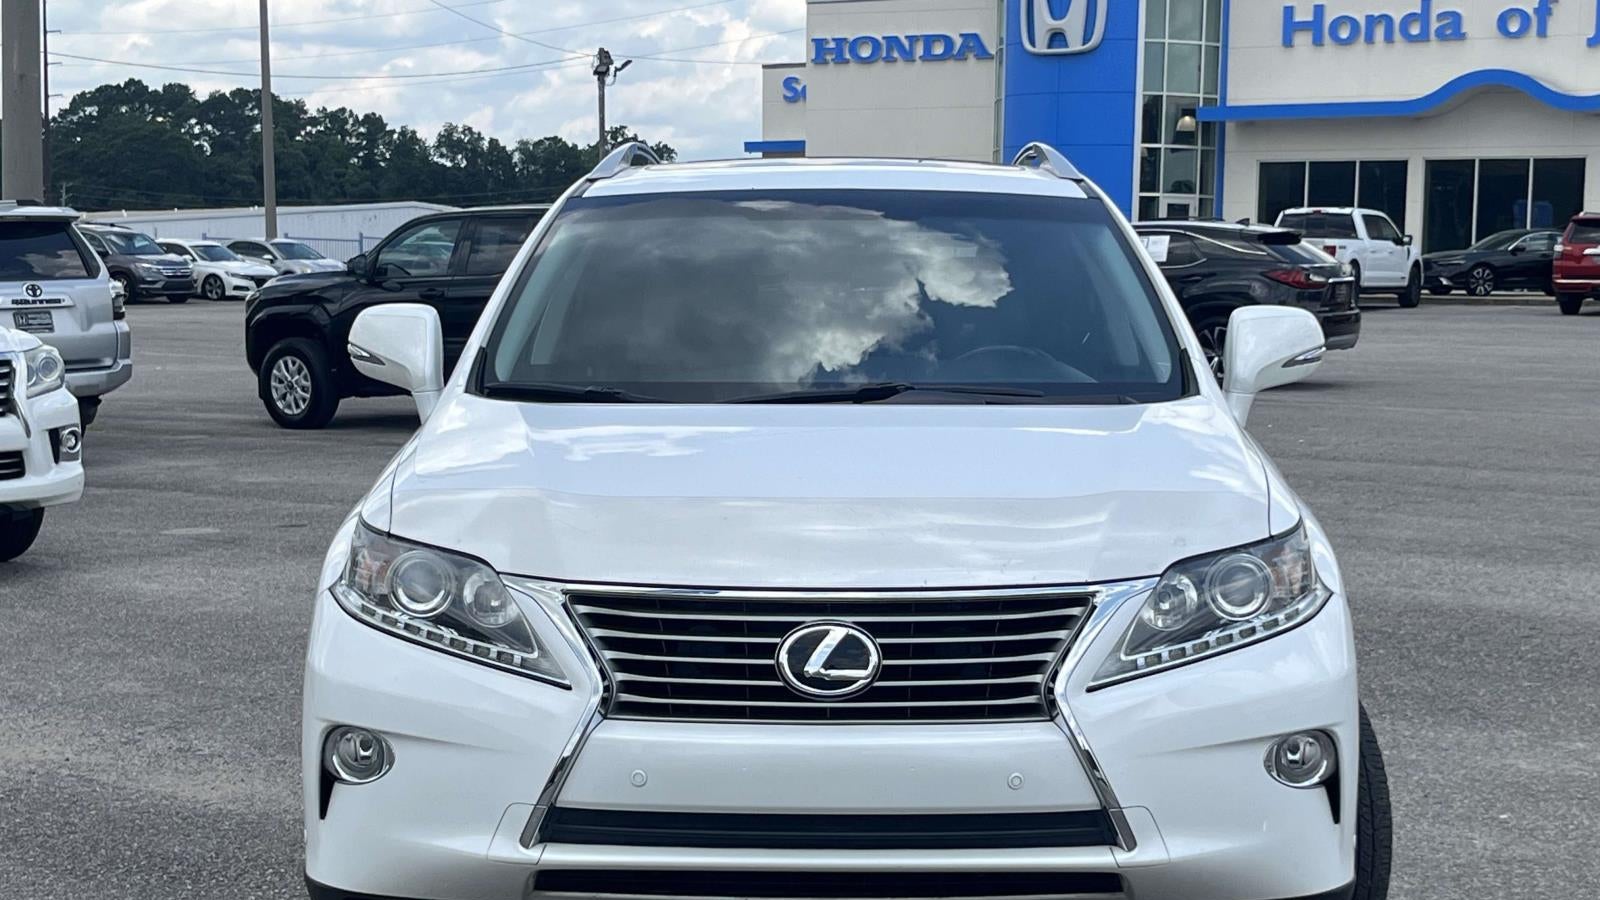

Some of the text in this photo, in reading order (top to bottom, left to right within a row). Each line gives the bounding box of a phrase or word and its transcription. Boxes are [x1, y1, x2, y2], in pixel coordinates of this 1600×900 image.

[1281, 0, 1467, 48] Honda
[1496, 0, 1557, 38] of
[811, 32, 994, 65] HONDA
